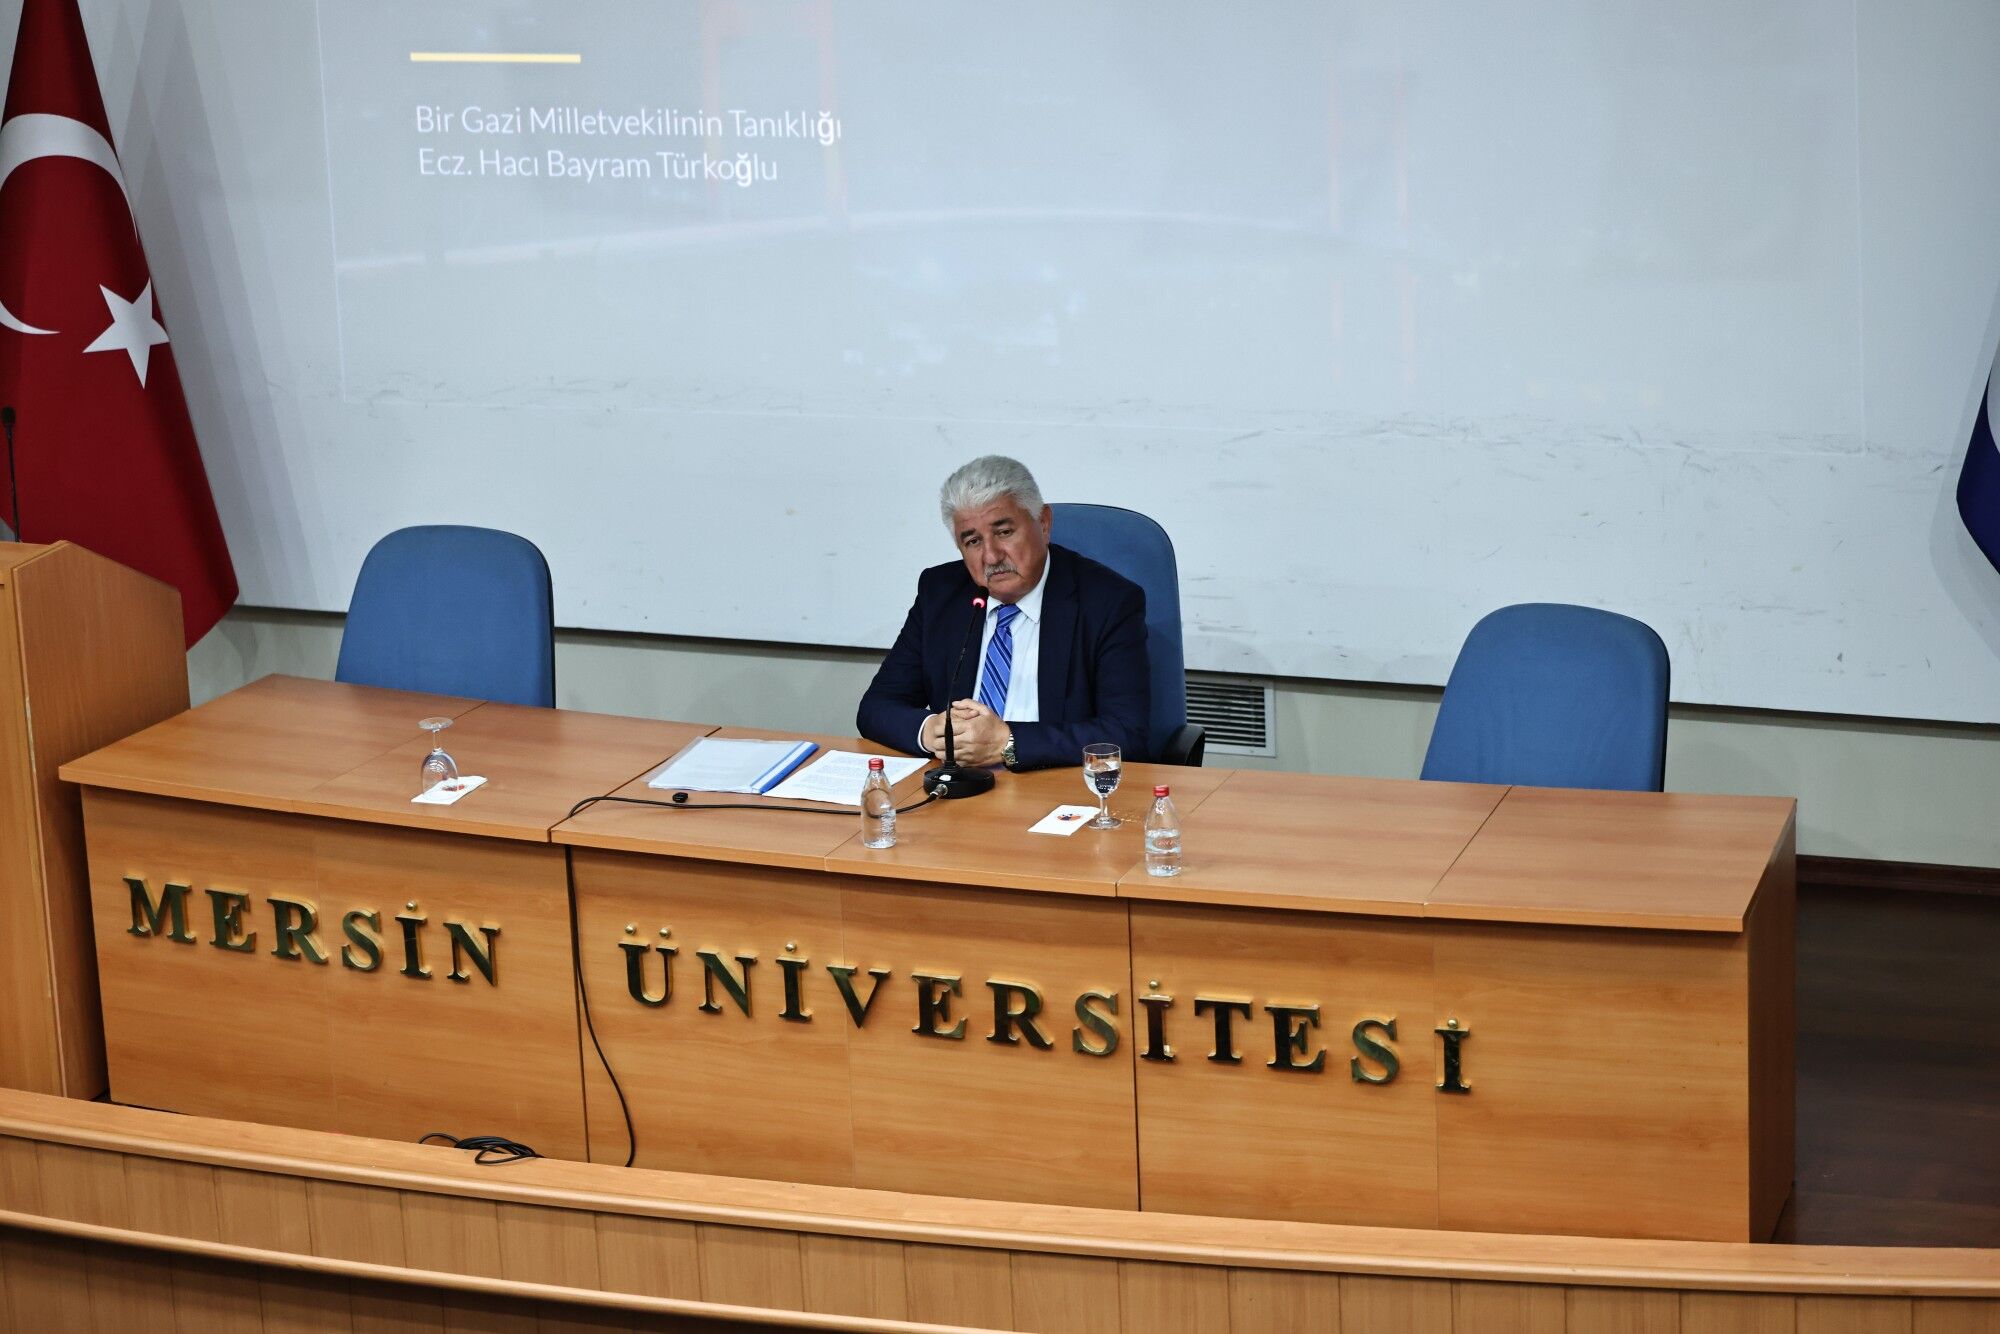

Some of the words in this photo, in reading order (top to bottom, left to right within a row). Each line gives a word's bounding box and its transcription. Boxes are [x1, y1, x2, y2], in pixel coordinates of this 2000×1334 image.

[416, 105, 454, 133] Bir
[461, 106, 521, 134] Gazi
[530, 106, 722, 137] Milletvekilinin
[728, 109, 842, 146] Tanıklığı
[419, 147, 472, 176] Ecz.
[479, 148, 539, 177] Hacı
[547, 149, 651, 183] Bayram
[656, 151, 778, 187] Türkoğlu
[123, 875, 501, 987] MERSİN
[617, 922, 1472, 1094] ÜNİVERSİTESİ
